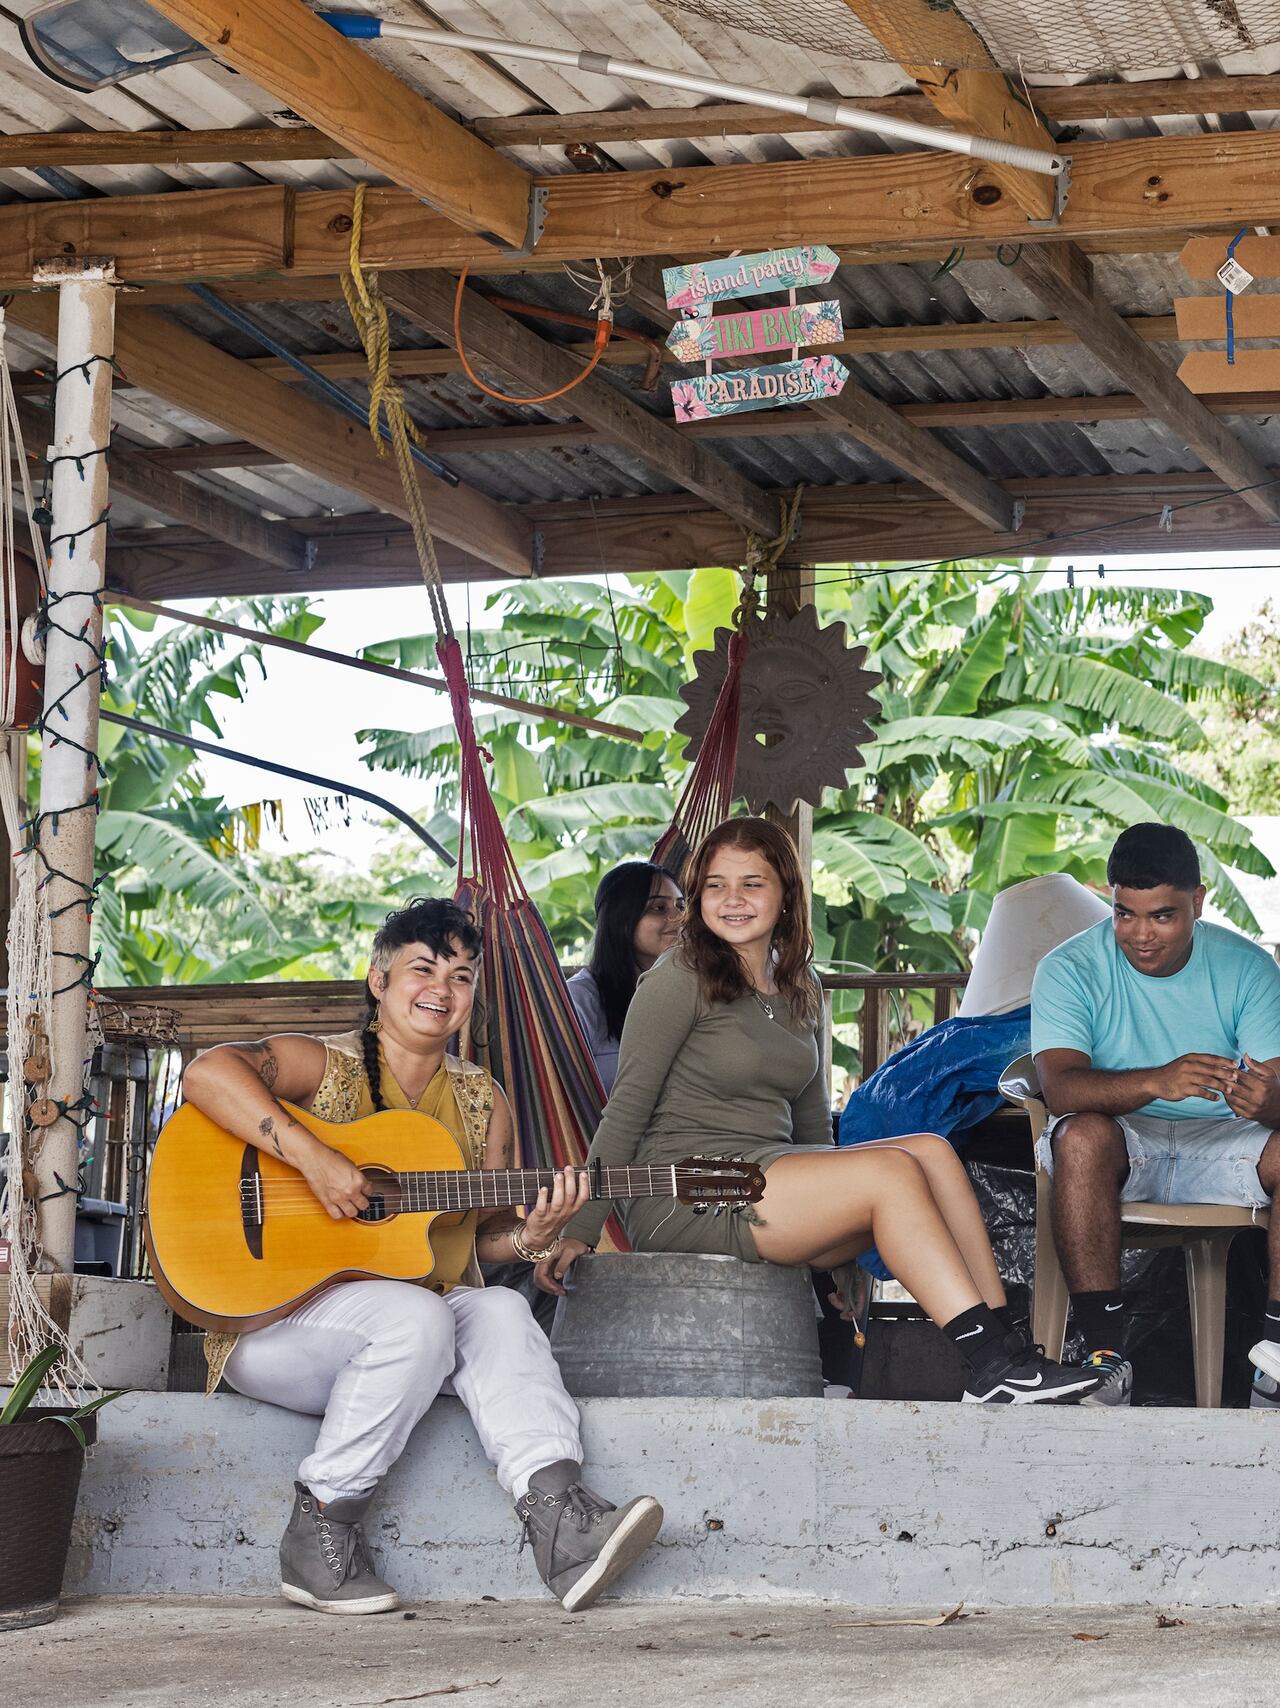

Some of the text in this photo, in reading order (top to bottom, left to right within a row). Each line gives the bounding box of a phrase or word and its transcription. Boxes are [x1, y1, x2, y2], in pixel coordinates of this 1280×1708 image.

[688, 256, 804, 300] island party
[712, 309, 806, 353] TIKI BAR
[703, 368, 815, 405] PARADISE
